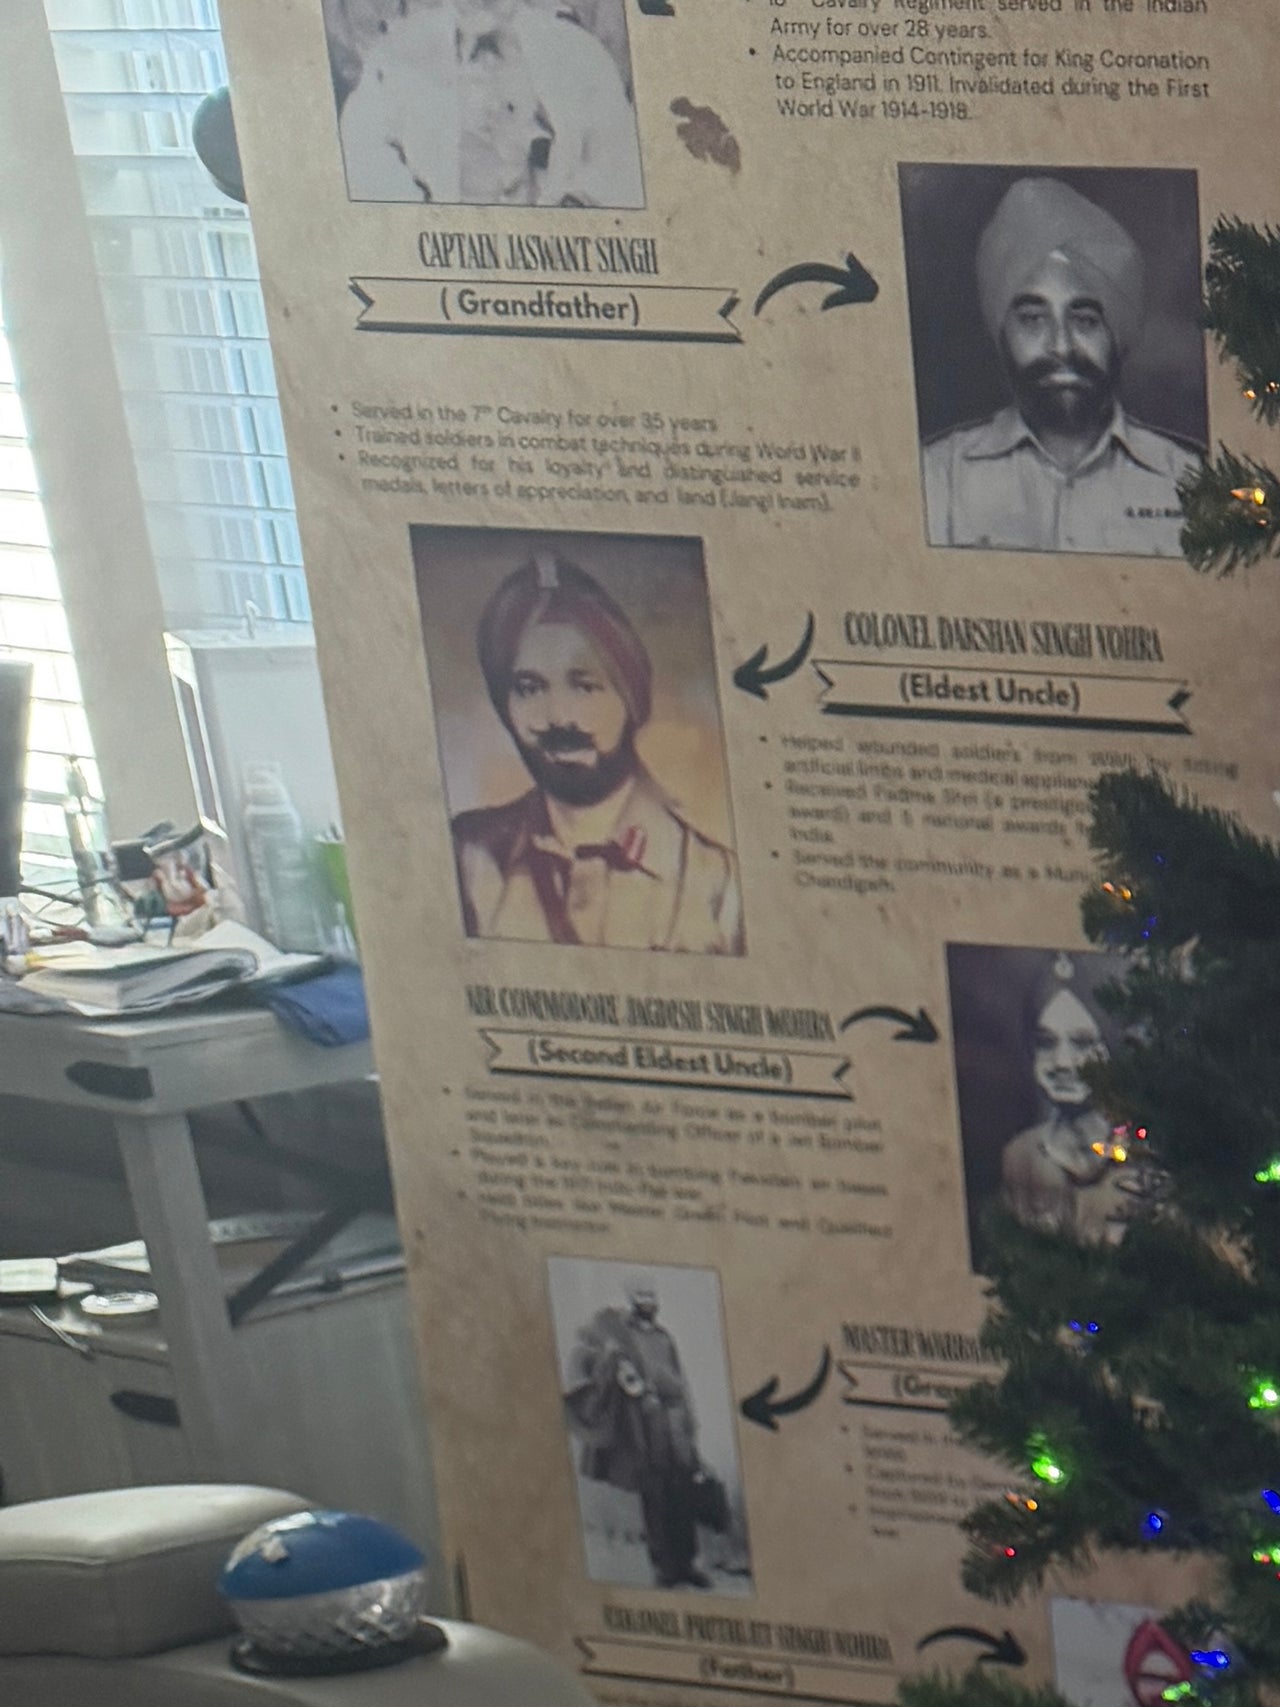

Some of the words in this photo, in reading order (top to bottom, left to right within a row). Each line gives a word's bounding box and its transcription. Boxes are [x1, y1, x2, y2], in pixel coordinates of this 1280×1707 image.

[770, 19, 821, 41] Army
[827, 19, 852, 37] for
[858, 22, 899, 39] over
[904, 20, 929, 38] 28
[934, 23, 991, 42] years.
[774, 45, 904, 68] Accompanied
[910, 47, 1016, 72] Contingent
[1023, 49, 1048, 67] for
[1055, 50, 1095, 74] King
[1100, 51, 1210, 71] Coronation
[776, 74, 795, 91] to
[802, 73, 876, 95] England
[883, 74, 900, 91] in
[949, 74, 1055, 96] Invalidated
[1061, 77, 1121, 100] during
[1128, 79, 1160, 97] the
[1166, 78, 1209, 99] First
[776, 99, 834, 118] World
[840, 100, 876, 119] War
[419, 231, 500, 268] CAPTAIN
[504, 233, 594, 272] JASWANT
[595, 237, 660, 275] SINGH
[351, 401, 412, 421] Served
[417, 403, 434, 420] in
[438, 405, 467, 422] the
[497, 406, 562, 428] Cavalry
[355, 425, 421, 447] Trained
[844, 610, 934, 650] COLONEL
[1030, 620, 1093, 659] SINGH
[900, 671, 991, 703] (Eldest
[996, 677, 1081, 714] Uncle)
[528, 1037, 629, 1068] (Second
[634, 1046, 709, 1076] Eldest
[714, 1052, 794, 1085] Uncle)
